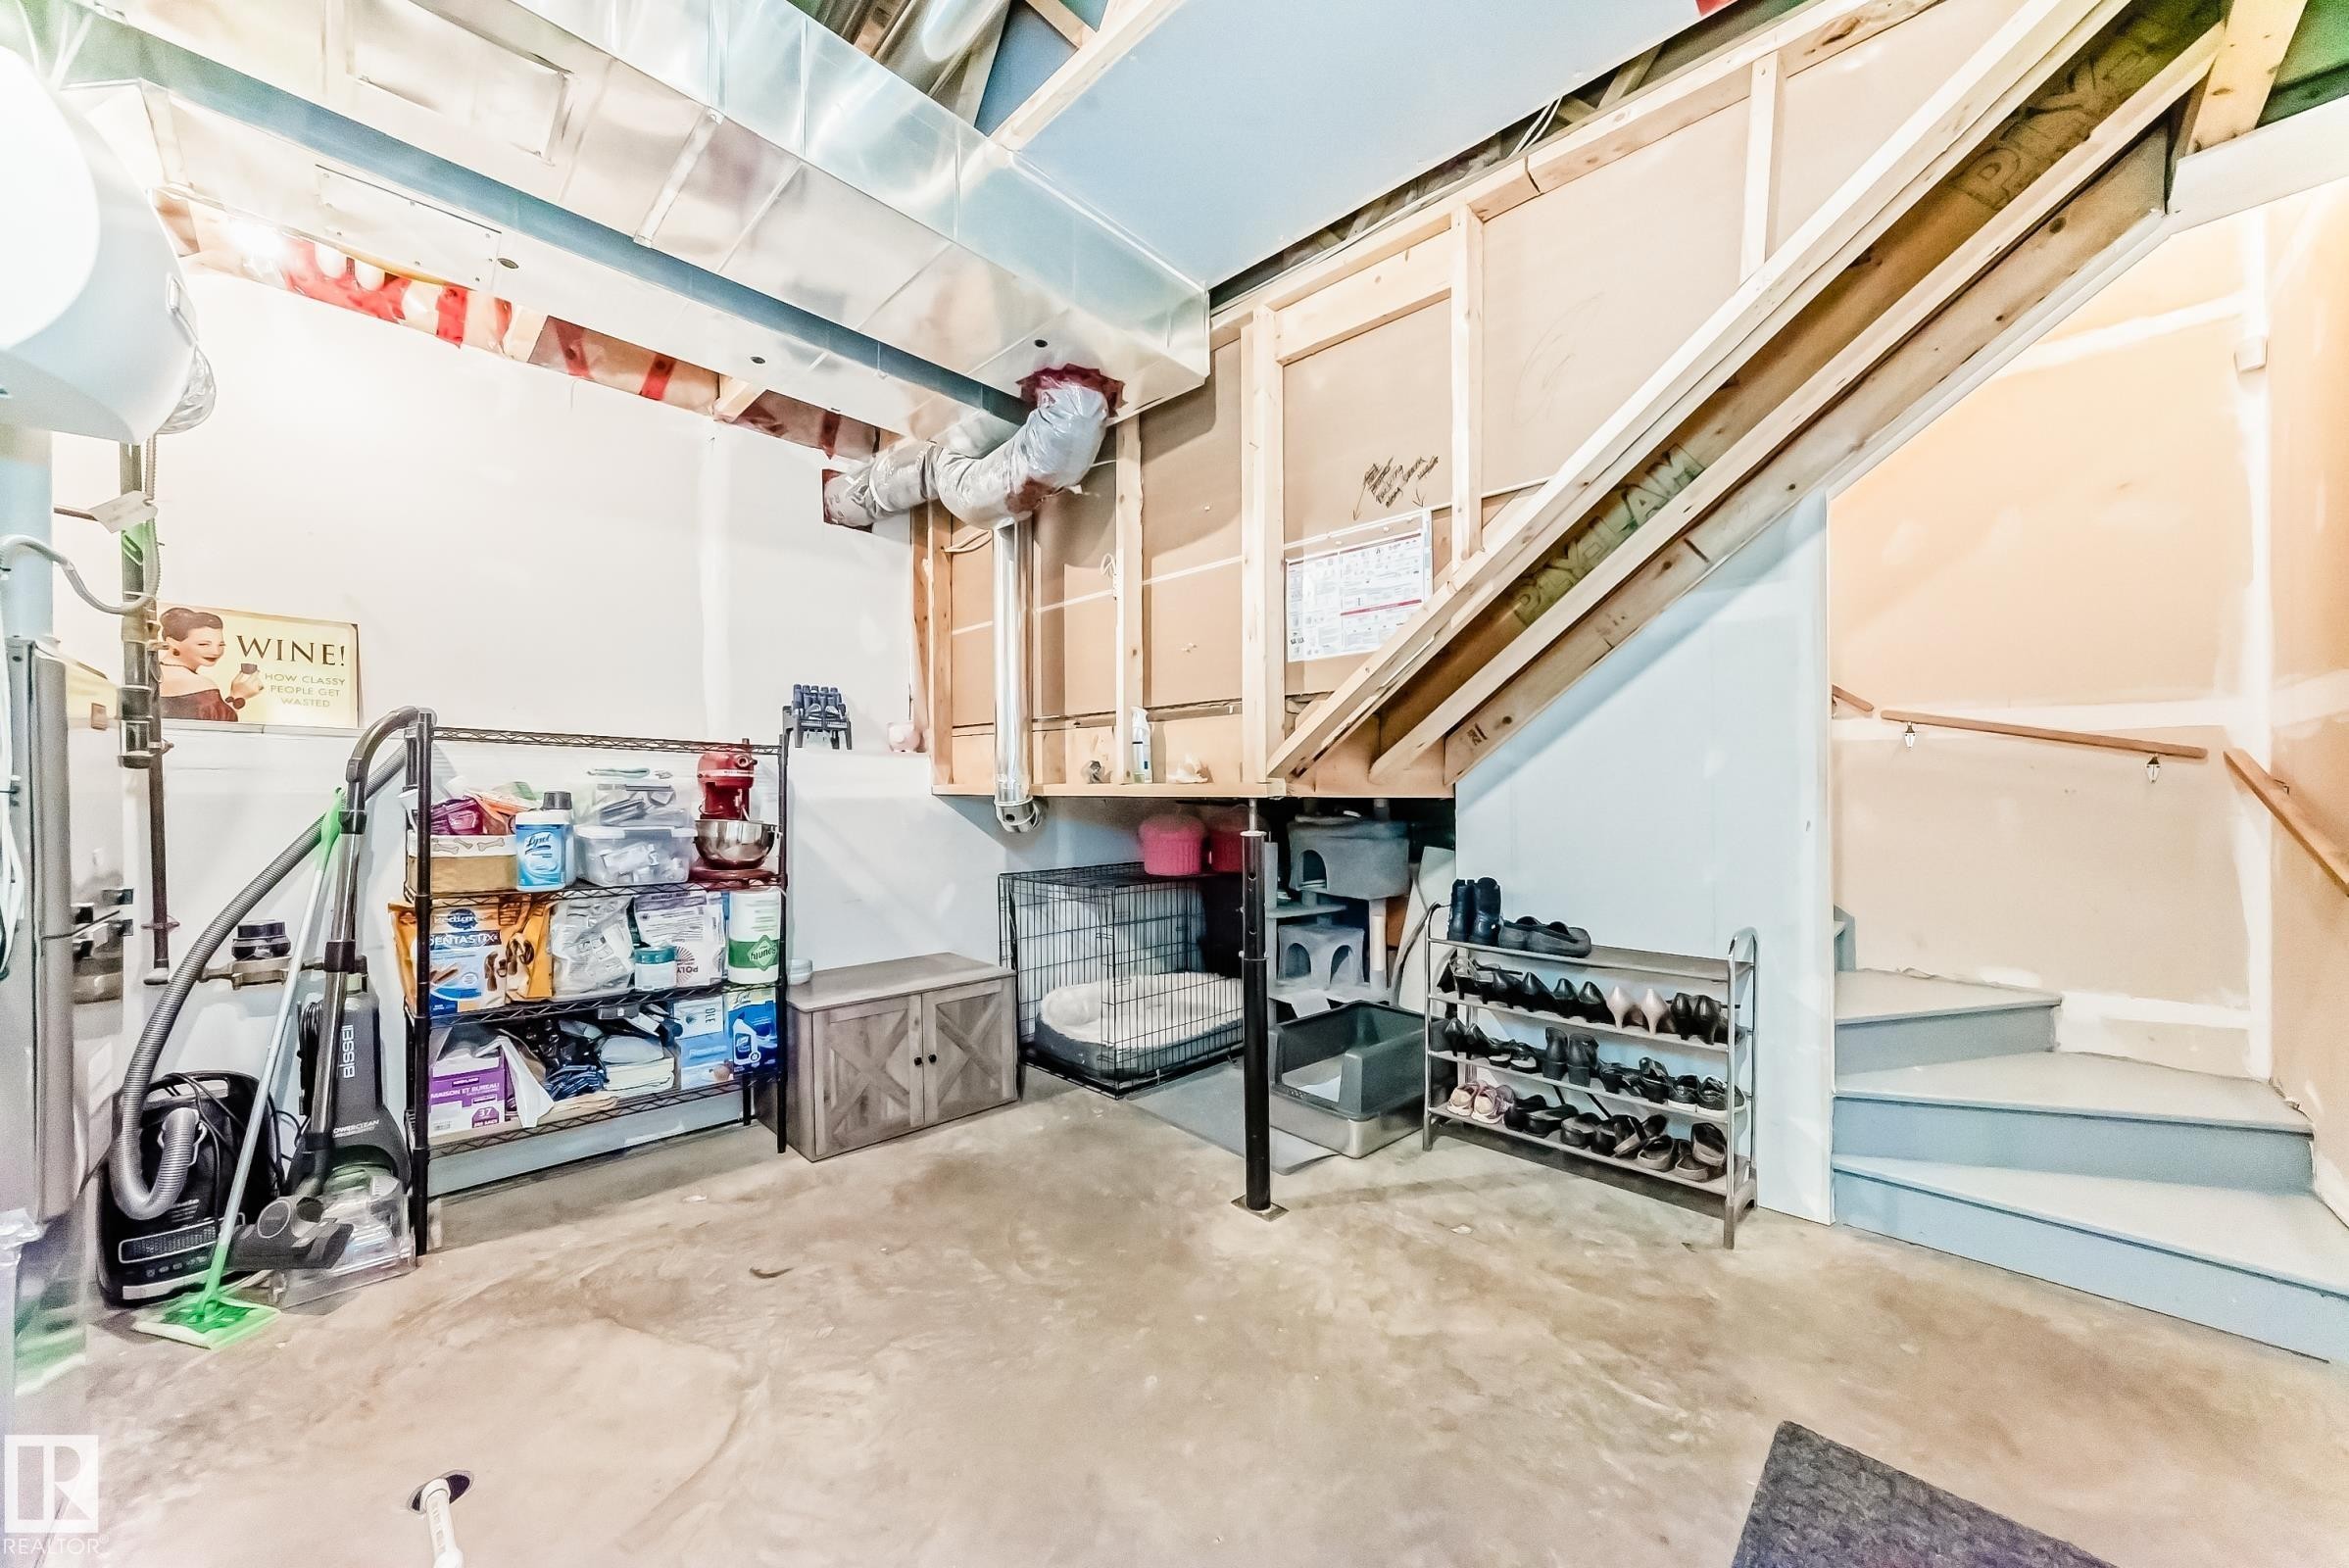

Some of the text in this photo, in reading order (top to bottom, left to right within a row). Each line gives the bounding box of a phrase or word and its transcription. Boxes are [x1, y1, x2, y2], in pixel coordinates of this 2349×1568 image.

[236, 635, 345, 666] WINE!
[265, 672, 346, 686] HOW CLASSY
[270, 685, 341, 697] PEOPLE GET
[281, 697, 330, 708] WASTED
[478, 1107, 492, 1117] 37
